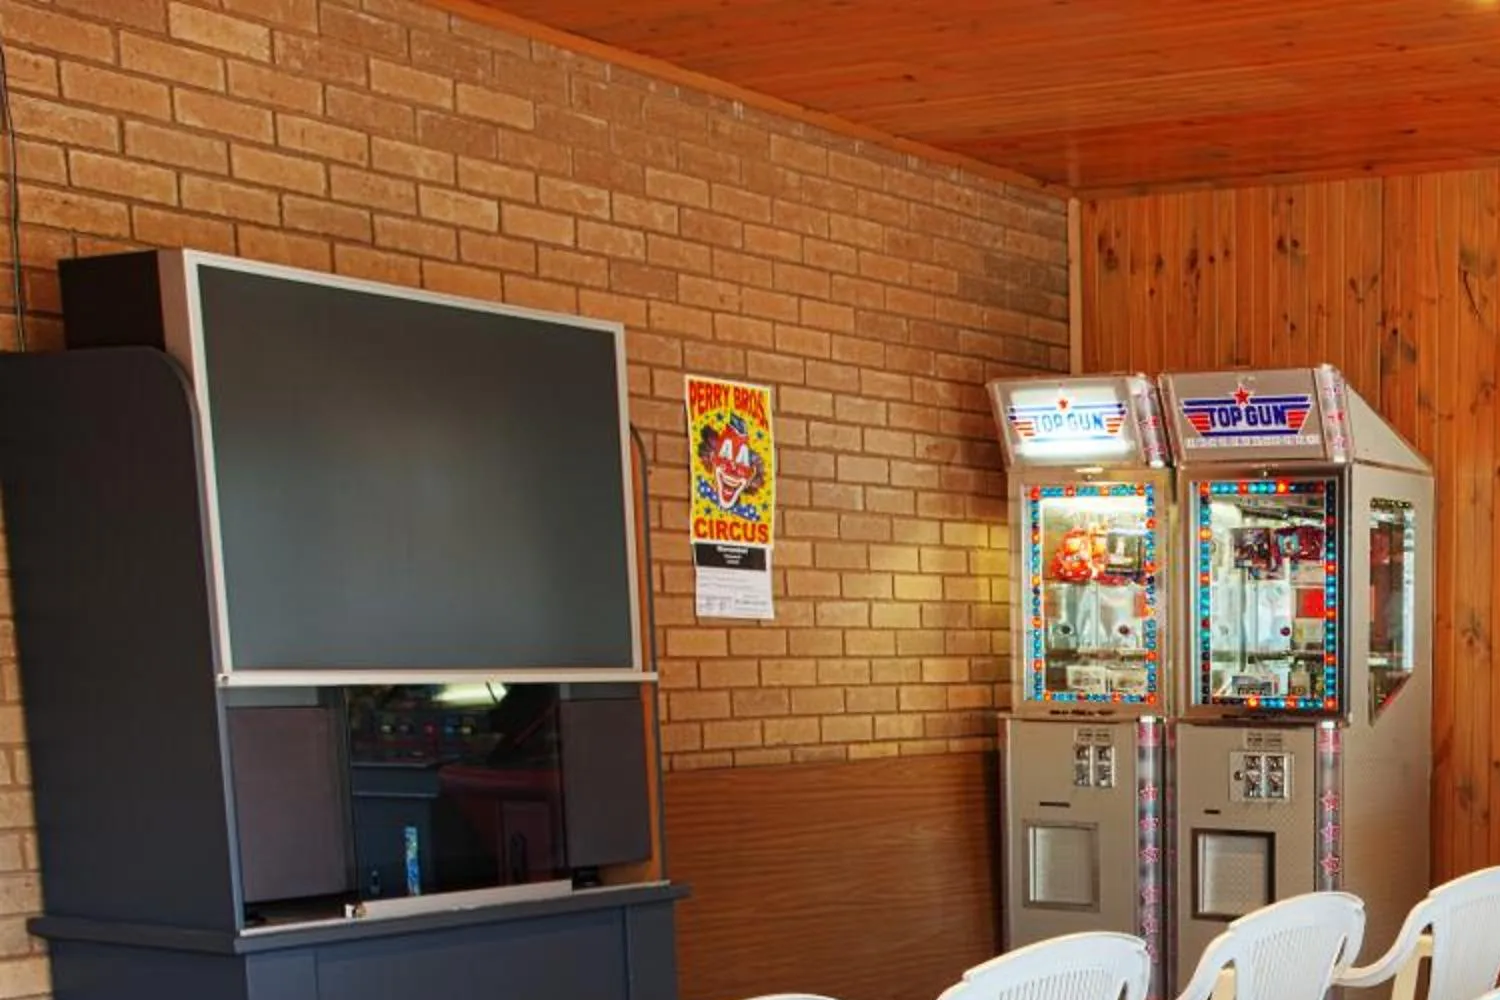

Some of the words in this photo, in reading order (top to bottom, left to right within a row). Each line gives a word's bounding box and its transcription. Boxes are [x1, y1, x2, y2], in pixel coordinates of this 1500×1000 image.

[689, 380, 729, 421] PERRY
[1032, 413, 1063, 434] TOP
[1066, 410, 1105, 433] GUN
[1207, 405, 1243, 428] TOP
[1245, 403, 1288, 427] GUN
[693, 517, 769, 544] CIRCUS
